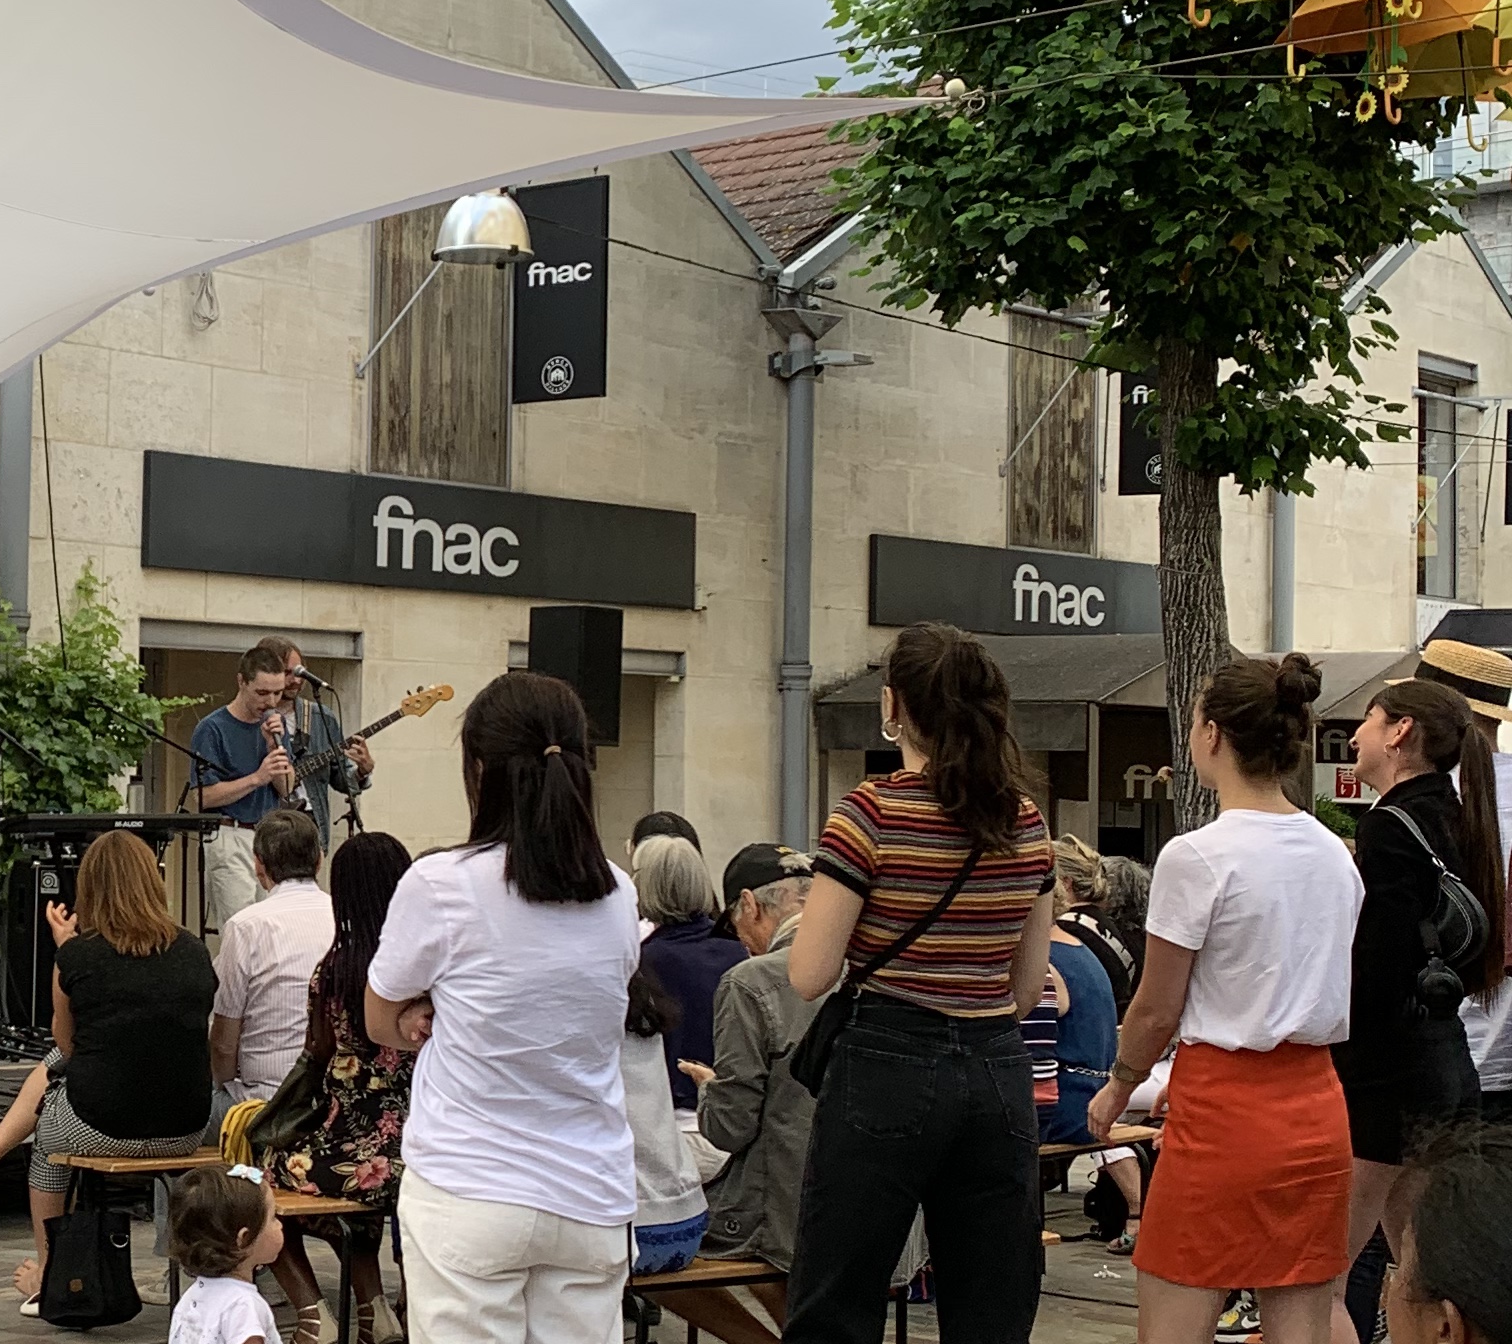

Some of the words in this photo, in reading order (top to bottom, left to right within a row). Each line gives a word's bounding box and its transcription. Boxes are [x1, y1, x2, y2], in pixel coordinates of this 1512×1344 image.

[527, 261, 592, 287] fnac
[373, 495, 520, 578] fnac
[1012, 563, 1105, 627] fnac
